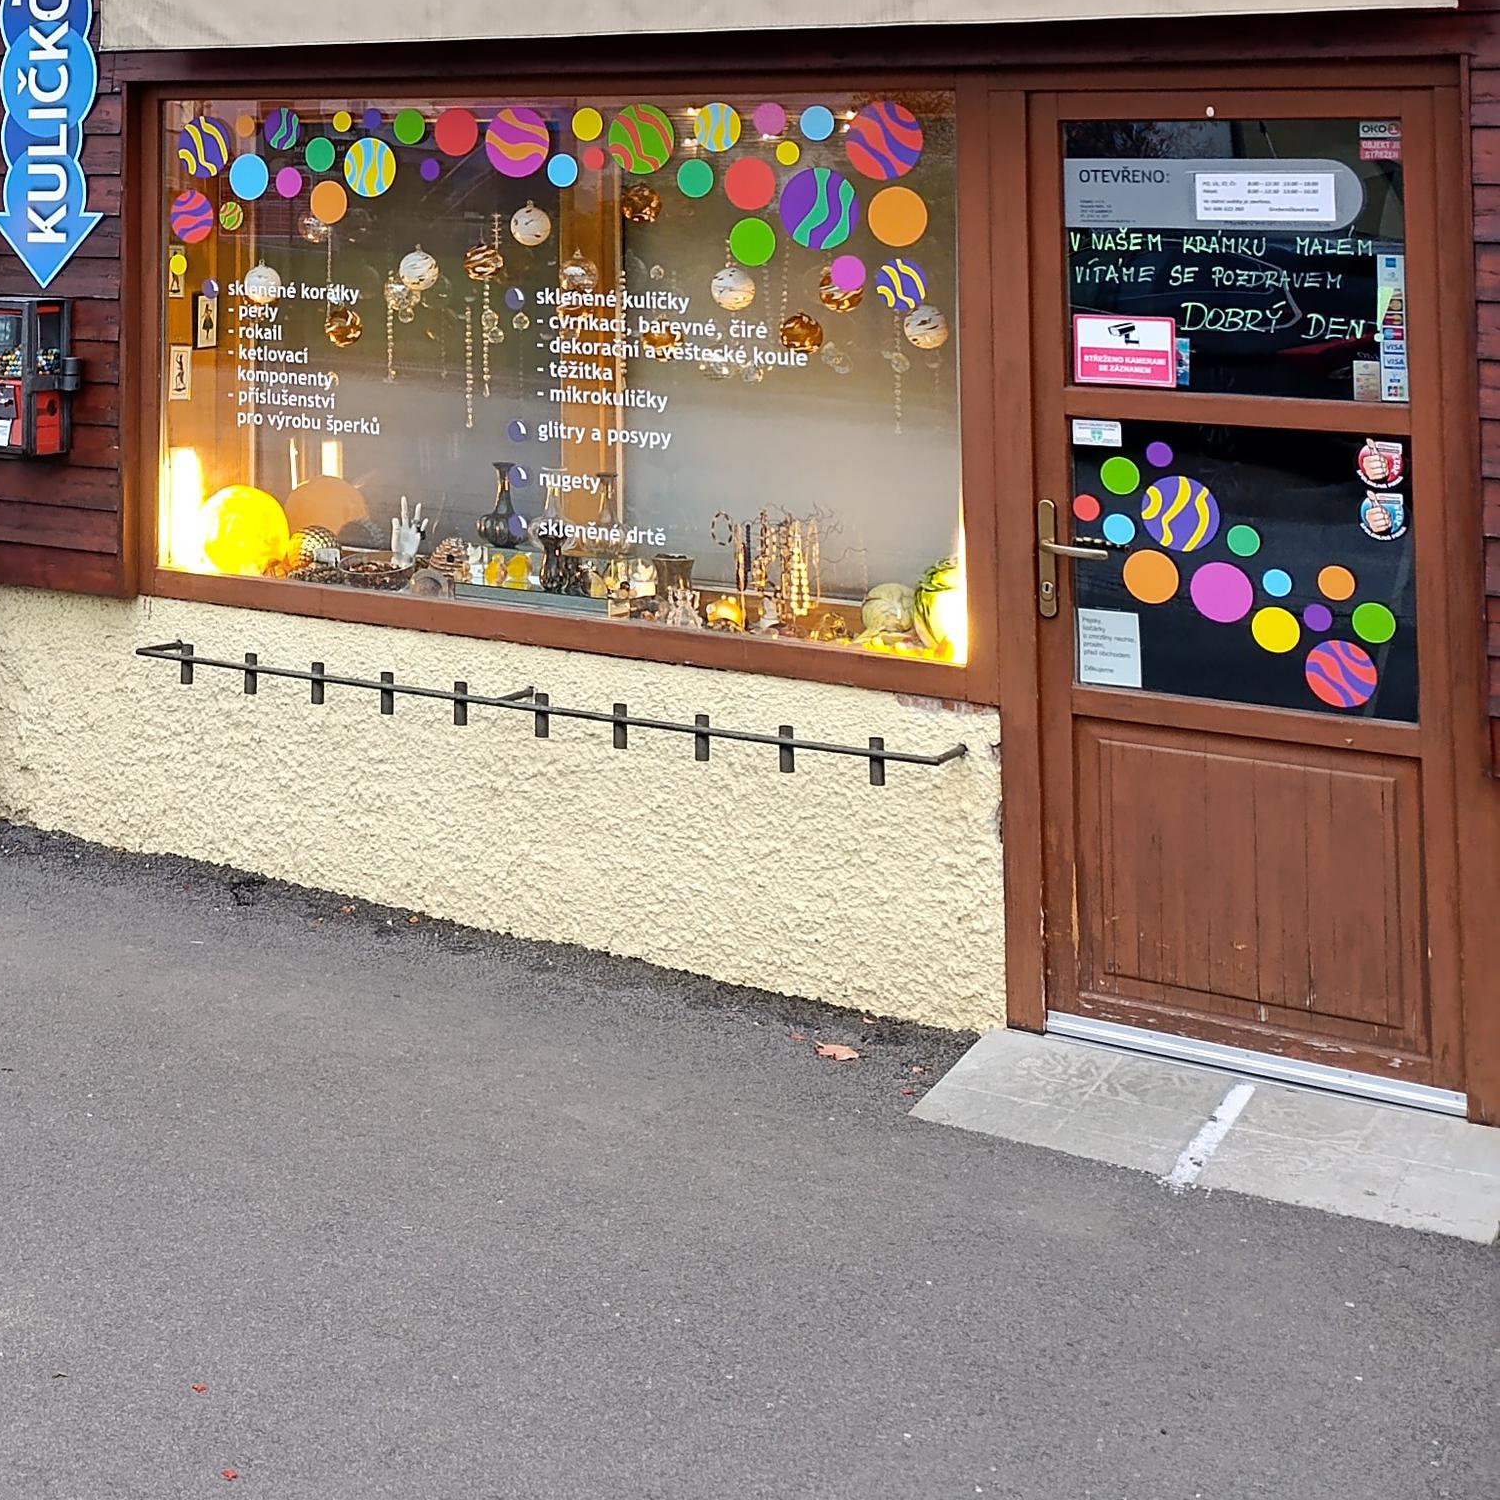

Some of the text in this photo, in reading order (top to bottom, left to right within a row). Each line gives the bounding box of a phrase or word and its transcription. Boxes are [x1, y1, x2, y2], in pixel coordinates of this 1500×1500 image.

[1078, 166, 1170, 184] OTEVŘENO:
[1070, 225, 1373, 257] V NAŠEM KRÁMKU MALÉM
[1075, 258, 1343, 290] VÍTÁME SE POZDRAVEM
[228, 280, 360, 305] skleněné korálky
[536, 288, 690, 315] skleněné kuličky
[238, 303, 279, 322] perly
[1180, 301, 1287, 334] DOBRÝ
[238, 325, 282, 341] rokail
[639, 315, 722, 340] barevné,
[729, 320, 768, 340] čiré
[238, 345, 309, 364] ketlovací
[550, 338, 639, 359] dekorační
[645, 348, 656, 359] a
[753, 347, 809, 367] koule
[237, 365, 333, 390] komponenty
[550, 363, 613, 382] těžítka
[238, 388, 336, 410] příslušenství
[550, 387, 668, 413] mikrokuličky
[237, 412, 380, 435] pro výrobu šperků
[538, 421, 672, 450] glitry a posypy
[539, 473, 601, 494] nugety
[539, 519, 667, 546] skleněné drtě
